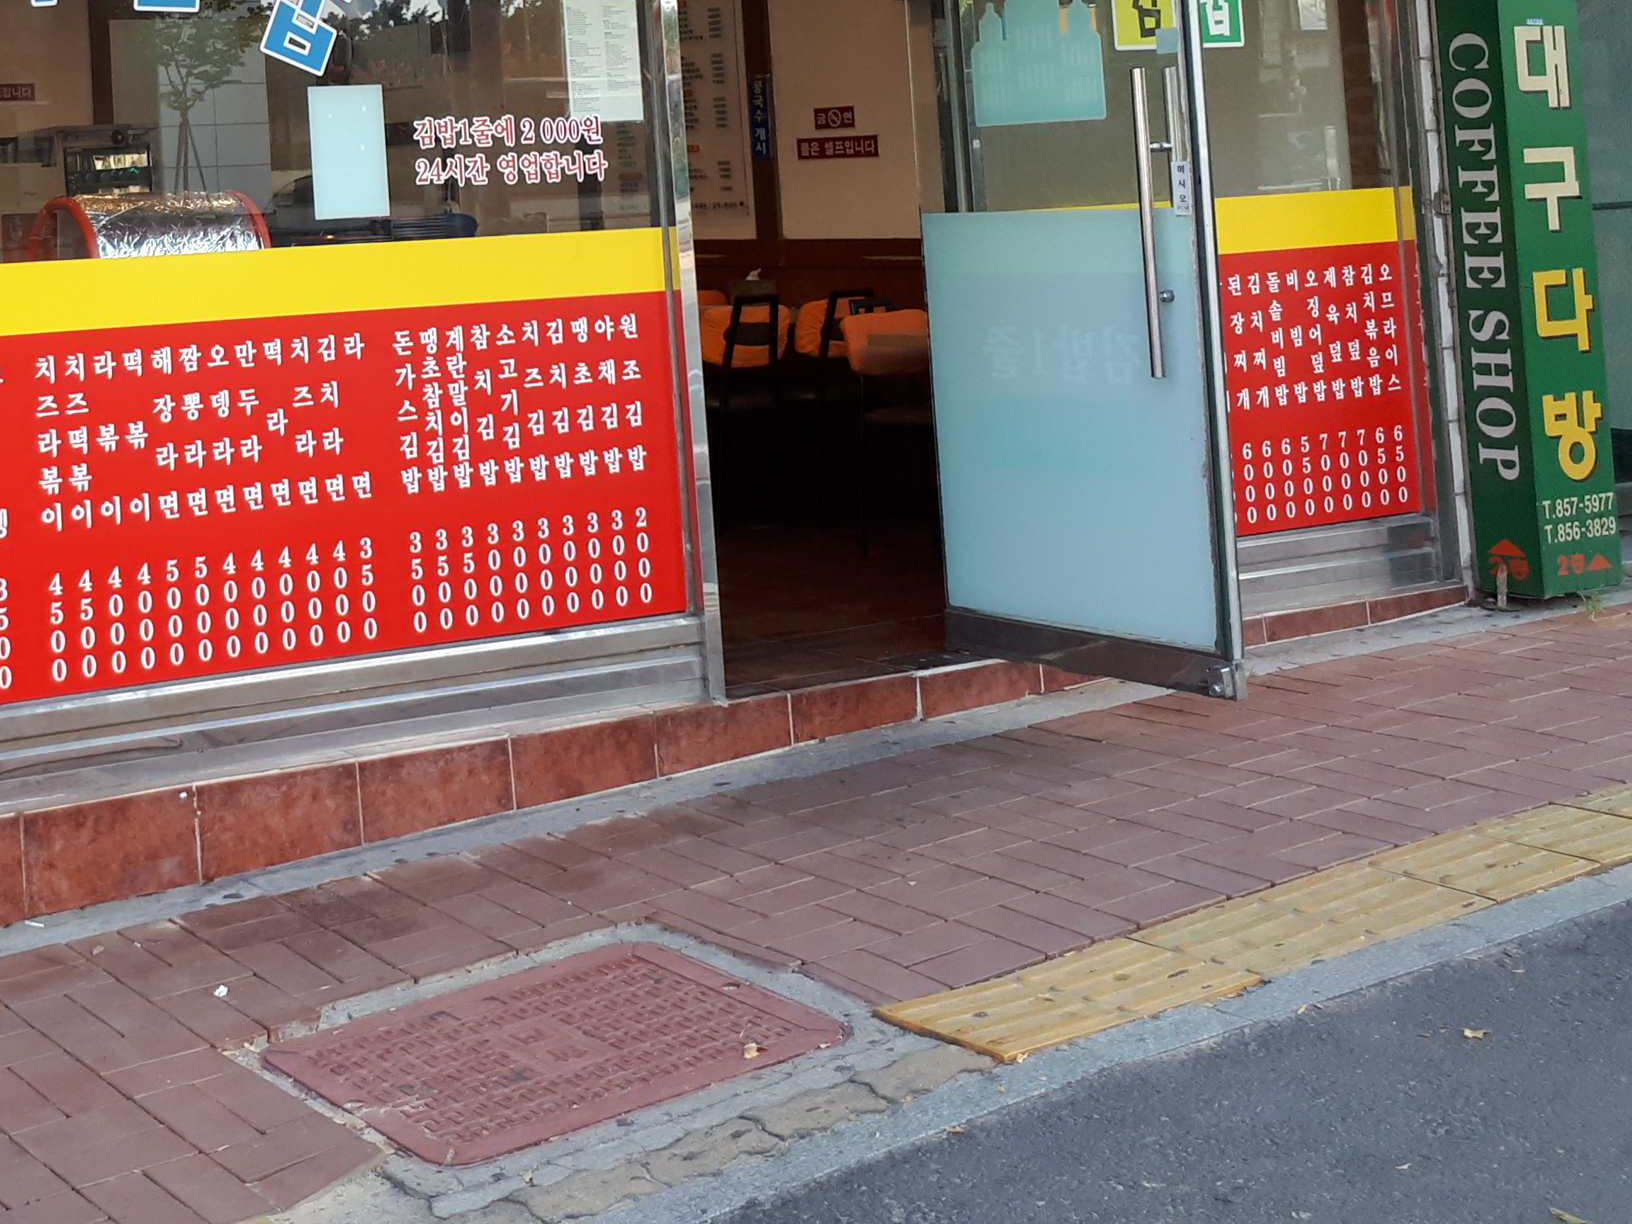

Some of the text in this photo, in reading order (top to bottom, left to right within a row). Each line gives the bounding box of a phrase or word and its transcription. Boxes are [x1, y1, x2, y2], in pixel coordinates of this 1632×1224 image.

[414, 114, 515, 149] 김밥1줄에
[415, 148, 609, 187] 24시간 영업합니다
[824, 139, 876, 156] 셀프입니다
[1449, 33, 1521, 481] COFFEE SHOP
[35, 355, 67, 681] 치즈라볶이 4500
[65, 353, 96, 677] 치즈떡볶이 4500
[94, 351, 126, 673] 라볶이 4000
[122, 349, 155, 669] 떡볶이 4000
[151, 347, 184, 665] 해장라면 5000
[179, 345, 212, 661] 짬뽕라면 5000
[207, 345, 240, 657] 오뎅라면 4000
[234, 341, 268, 654] 만두라면 4000
[263, 338, 296, 650] 떡라면 4000
[291, 336, 323, 646] 치즈라면 4000
[318, 335, 350, 643] 김치라면 4000
[393, 330, 427, 632] 돈가스김밥 3500
[419, 327, 453, 629] 땡초참치김밥 3500
[446, 325, 478, 626] 계란말이김밥 3500
[471, 324, 504, 622] 참치김밥 3000
[496, 324, 529, 619] 소고기김밥 3000
[522, 320, 554, 616] 치즈김밥 3000
[547, 319, 579, 612] 김치김밥 3000
[570, 317, 604, 609] 땡초김밥 3000
[595, 315, 628, 606] 야채김밥 3000
[619, 313, 652, 603] 원조김밥 2000
[1228, 274, 1257, 523] 된장찌개 6000
[1248, 273, 1276, 520] 김치찌개 6000
[1266, 272, 1295, 518] 돌솥비빔밥 6000
[1286, 270, 1315, 515] 비빔밥 5500
[1305, 270, 1333, 512] 오징어덮밥 7000
[1324, 267, 1353, 510] 제육덮밥 7000
[1342, 265, 1372, 508] 참치덮밥 7000
[1361, 264, 1390, 506] 김치볶음밥 6500
[1379, 264, 1409, 503] 오므라이스 6500
[1542, 492, 1614, 520] T.857-5977
[1544, 516, 1617, 544] T.856-3829
[361, 537, 379, 640] 3500
